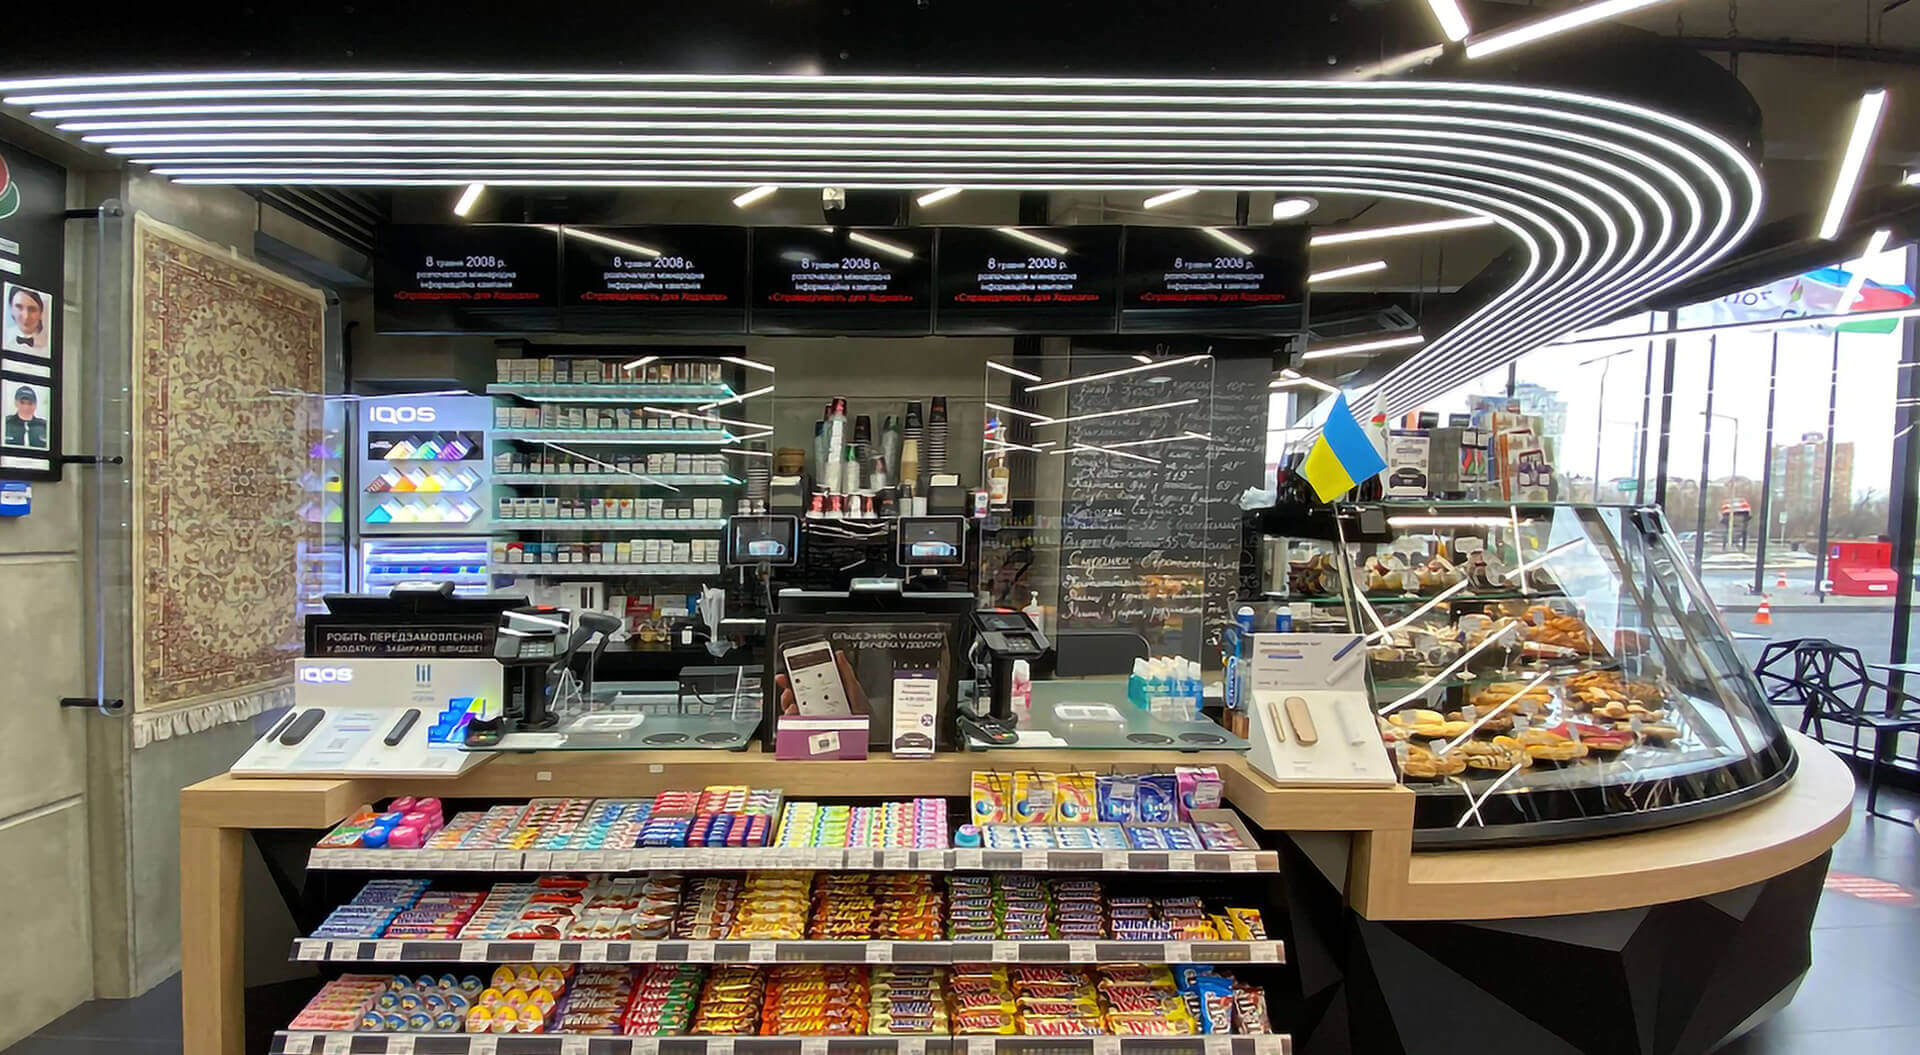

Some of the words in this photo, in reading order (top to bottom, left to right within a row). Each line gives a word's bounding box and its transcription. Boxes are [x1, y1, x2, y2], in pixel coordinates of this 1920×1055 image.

[426, 256, 434, 267] 8
[466, 256, 496, 268] 2008
[614, 257, 622, 268] 8
[654, 257, 683, 268] 2008
[801, 258, 810, 269] 8
[842, 258, 870, 270] 2008
[988, 258, 996, 269] 8
[1028, 258, 1056, 269] 2008
[1174, 258, 1182, 269] 8
[1214, 258, 1244, 269] 2008
[369, 406, 437, 425] IQOS
[327, 632, 367, 642] РОБІТЬ
[370, 631, 483, 642] ПЕРЕДЗАМОВЛЕННЯ
[300, 667, 353, 683] IQOS
[1113, 920, 1170, 930] SNICKERS
[1034, 1020, 1082, 1035] TWIX
[1125, 1020, 1170, 1034] TWIX
